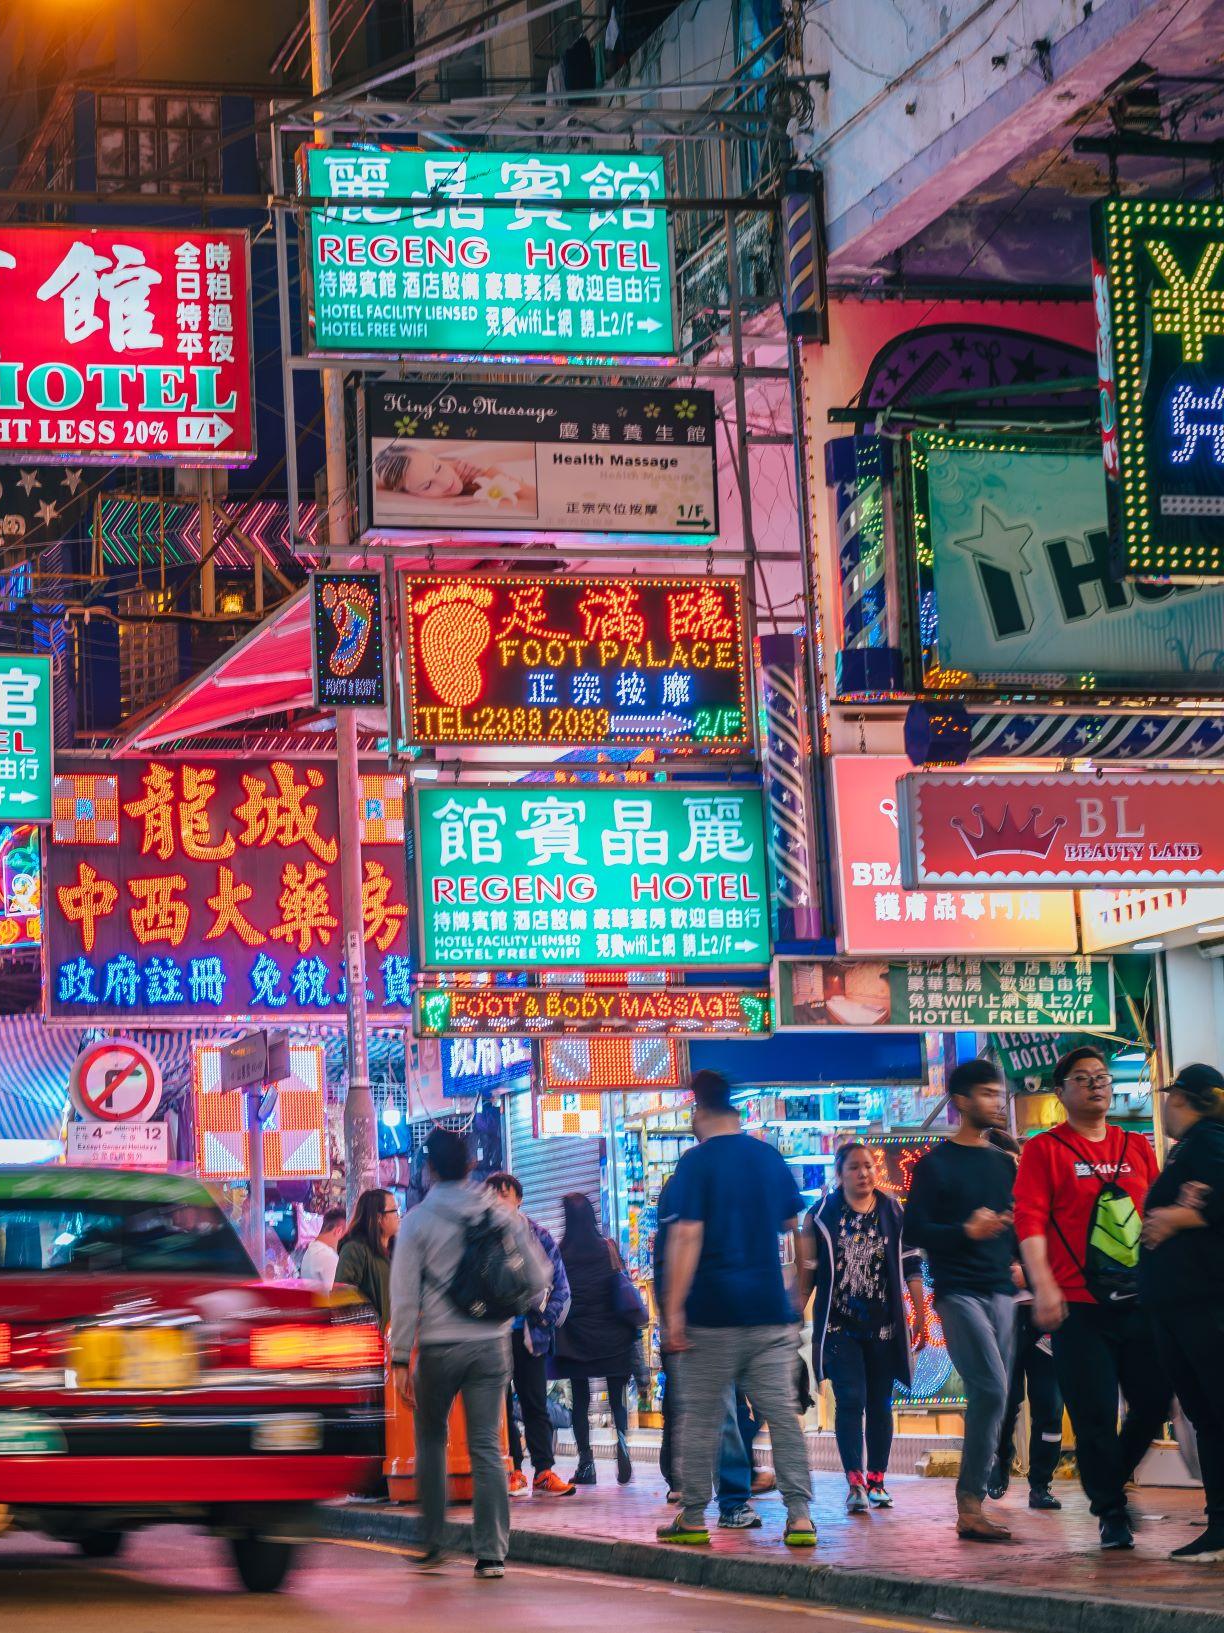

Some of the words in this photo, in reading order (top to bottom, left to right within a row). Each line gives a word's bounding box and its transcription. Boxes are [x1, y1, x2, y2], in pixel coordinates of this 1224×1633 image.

[318, 235, 490, 267] REGENG
[526, 238, 660, 271] HOTEL
[174, 242, 203, 361] 全日特平
[206, 242, 235, 363] 時租過夜
[321, 304, 363, 319] HOTEL
[367, 305, 422, 320] FACILITY
[321, 321, 364, 336] HOTEL
[367, 322, 396, 337] FREE
[400, 323, 428, 337] WIFI
[472, 394, 558, 422] Massage
[38, 419, 116, 444] LESS
[123, 420, 169, 445] 20%
[553, 453, 604, 466] Health
[610, 454, 678, 469] Massage
[677, 504, 704, 518] 1/F
[497, 639, 589, 668] FOOT
[598, 640, 736, 670] PALACE
[548, 706, 610, 736] 2093
[694, 709, 742, 737] 2/F
[123, 761, 338, 865] 龍城
[1076, 795, 1146, 838] BL
[1064, 842, 1145, 862] BEAUTY
[1149, 842, 1203, 862] LAND
[431, 873, 597, 905] REGENG
[630, 872, 760, 902] HOTEL
[434, 936, 474, 947] HOTEL
[477, 935, 528, 947] FACILITY
[435, 948, 493, 960] HOTEL
[497, 948, 537, 960] FREE
[541, 947, 581, 959] WIFI
[58, 953, 227, 1008] 政府註冊
[451, 996, 519, 1017] FOOT
[525, 997, 540, 1017] &
[546, 996, 615, 1017] BODY
[622, 996, 742, 1017] MASSAGE
[908, 1010, 975, 1024] HOTEL
[988, 1010, 1039, 1024] FREE
[1051, 1010, 1093, 1024] WIFI
[92, 1127, 104, 1140] 4
[145, 1127, 162, 1140] 12
